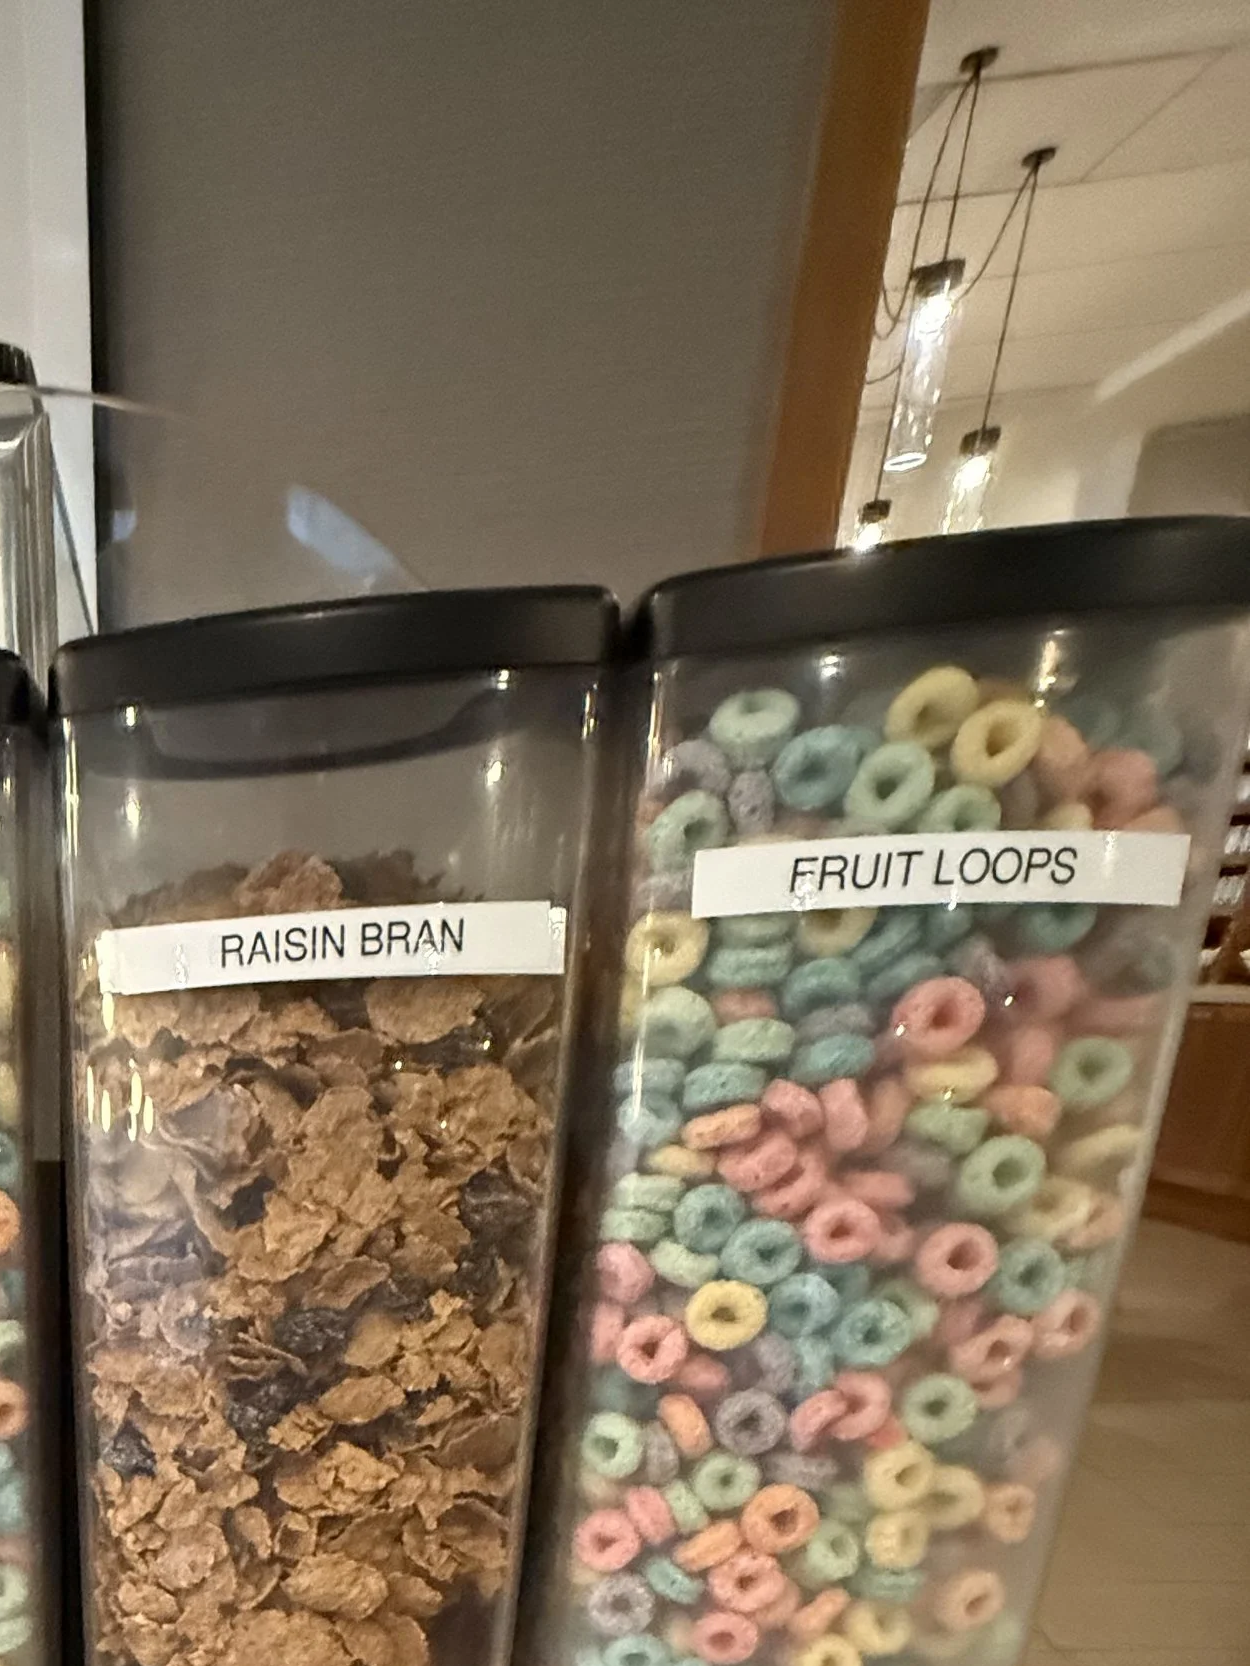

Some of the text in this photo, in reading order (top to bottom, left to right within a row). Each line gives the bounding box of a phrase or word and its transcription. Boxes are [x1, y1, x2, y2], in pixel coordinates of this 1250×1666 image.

[790, 846, 1078, 893] FRUIT LOOPS
[220, 918, 465, 969] RAISIN BRAN
